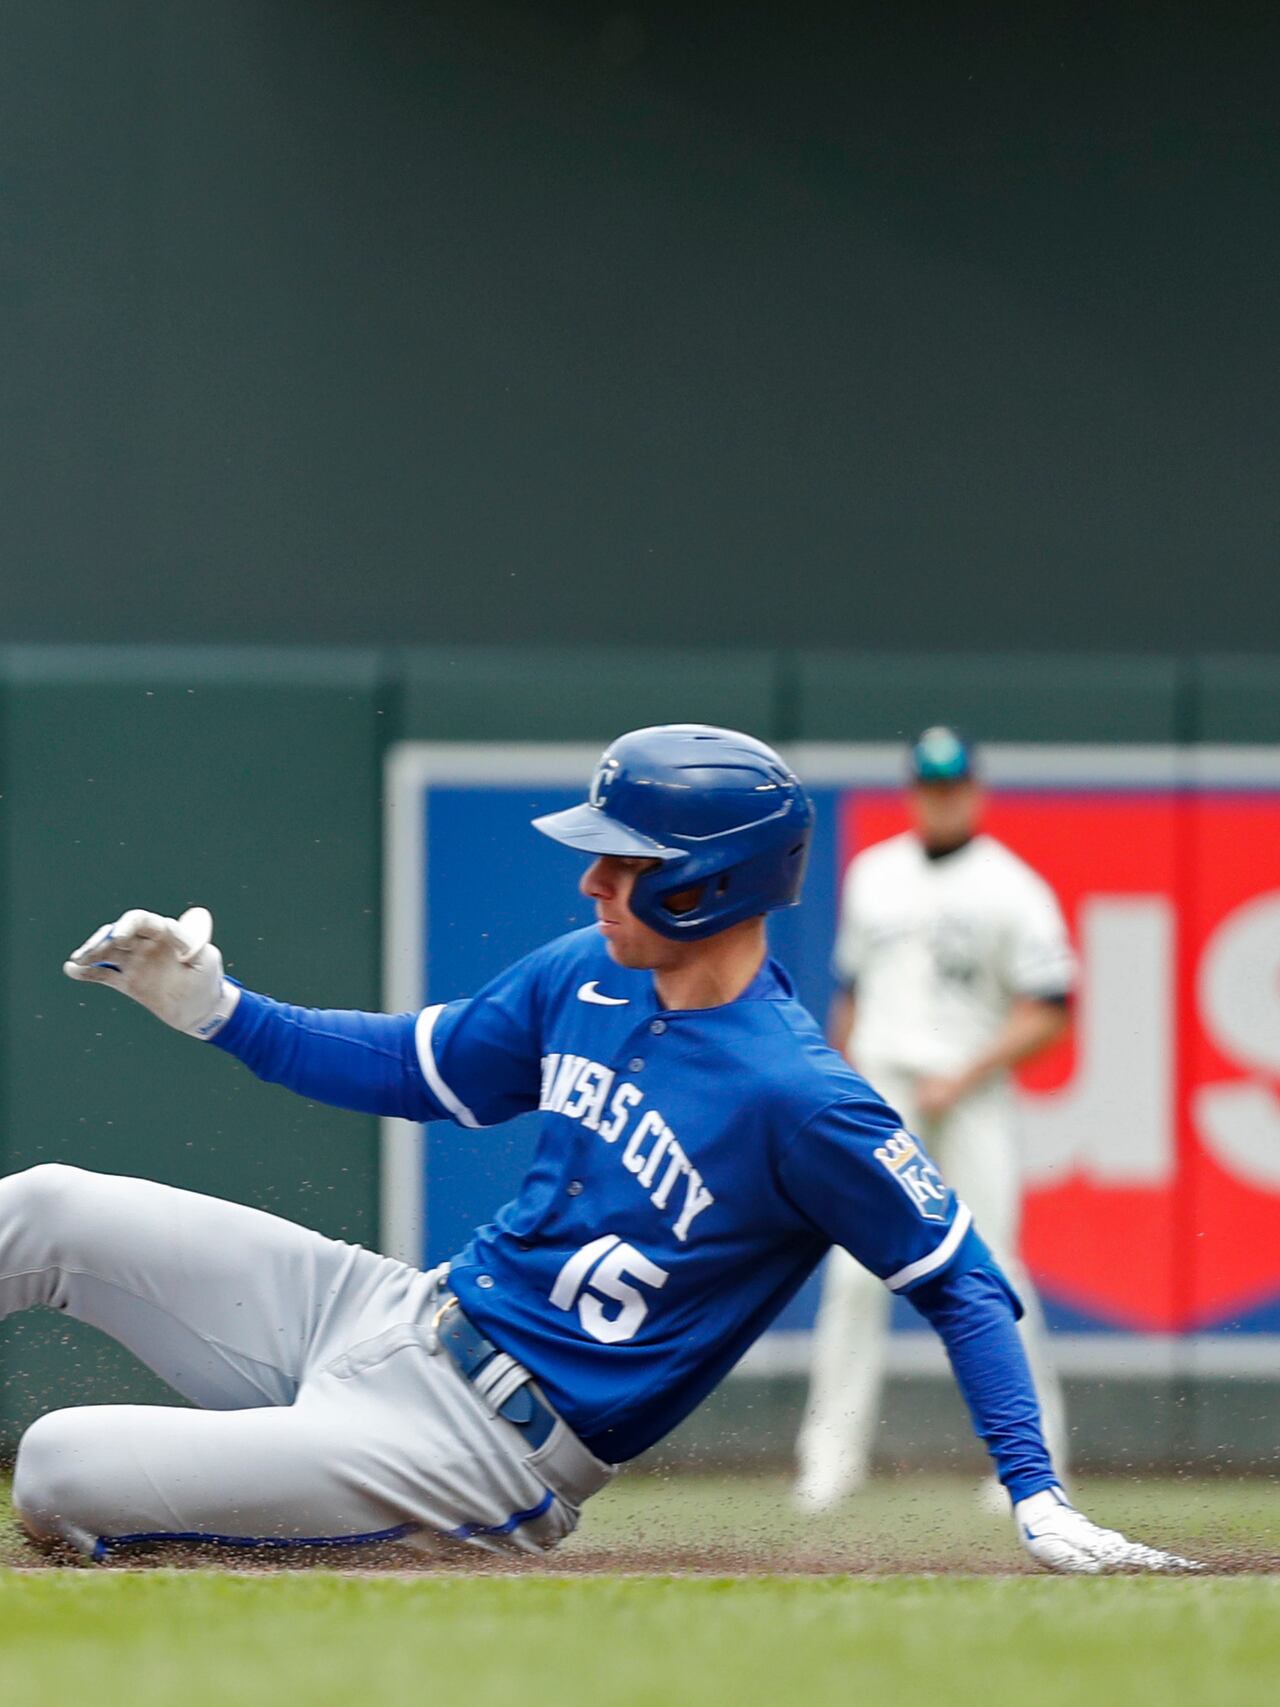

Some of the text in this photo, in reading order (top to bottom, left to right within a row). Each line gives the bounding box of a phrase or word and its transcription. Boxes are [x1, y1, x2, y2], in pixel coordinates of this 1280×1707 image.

[538, 1053, 714, 1242] ANSAS CITY
[548, 1234, 670, 1344] 15
